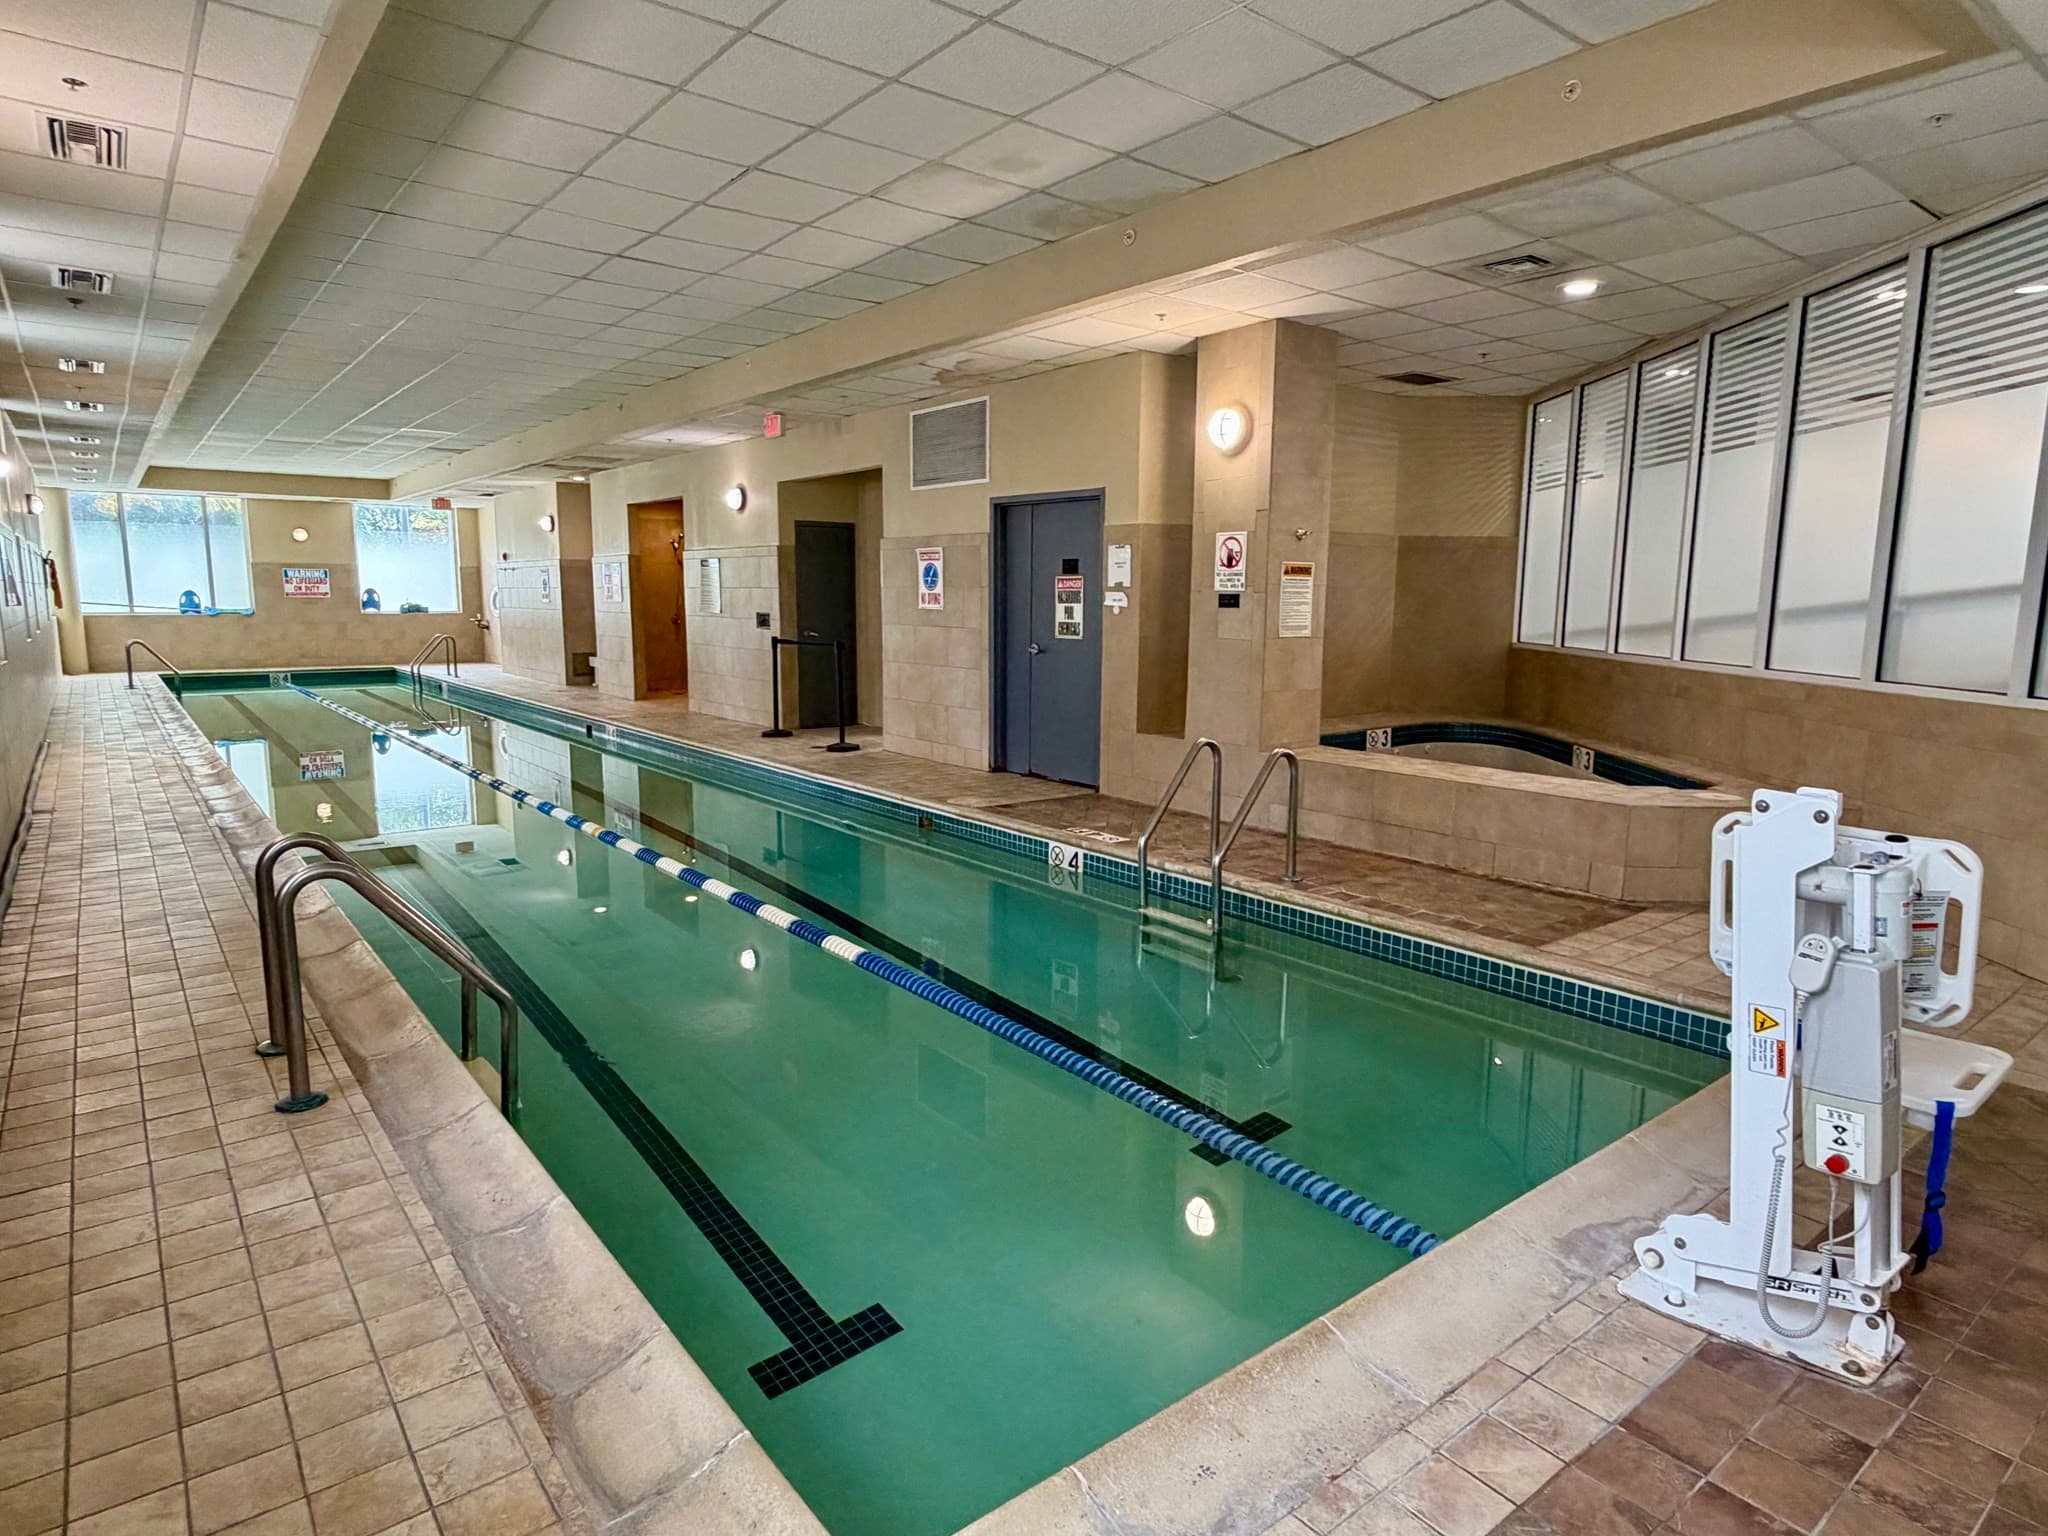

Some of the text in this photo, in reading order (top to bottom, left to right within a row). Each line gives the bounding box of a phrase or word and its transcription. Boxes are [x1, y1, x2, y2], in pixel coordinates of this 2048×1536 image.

[287, 570, 326, 578] WARNING
[1290, 566, 1312, 575] WARNING
[1063, 580, 1081, 588] DANGER
[921, 592, 927, 605] NO
[1381, 730, 1388, 747] 3
[1584, 751, 1591, 770] 3
[1068, 851, 1079, 871] 4
[1792, 1284, 1847, 1300] Smth
